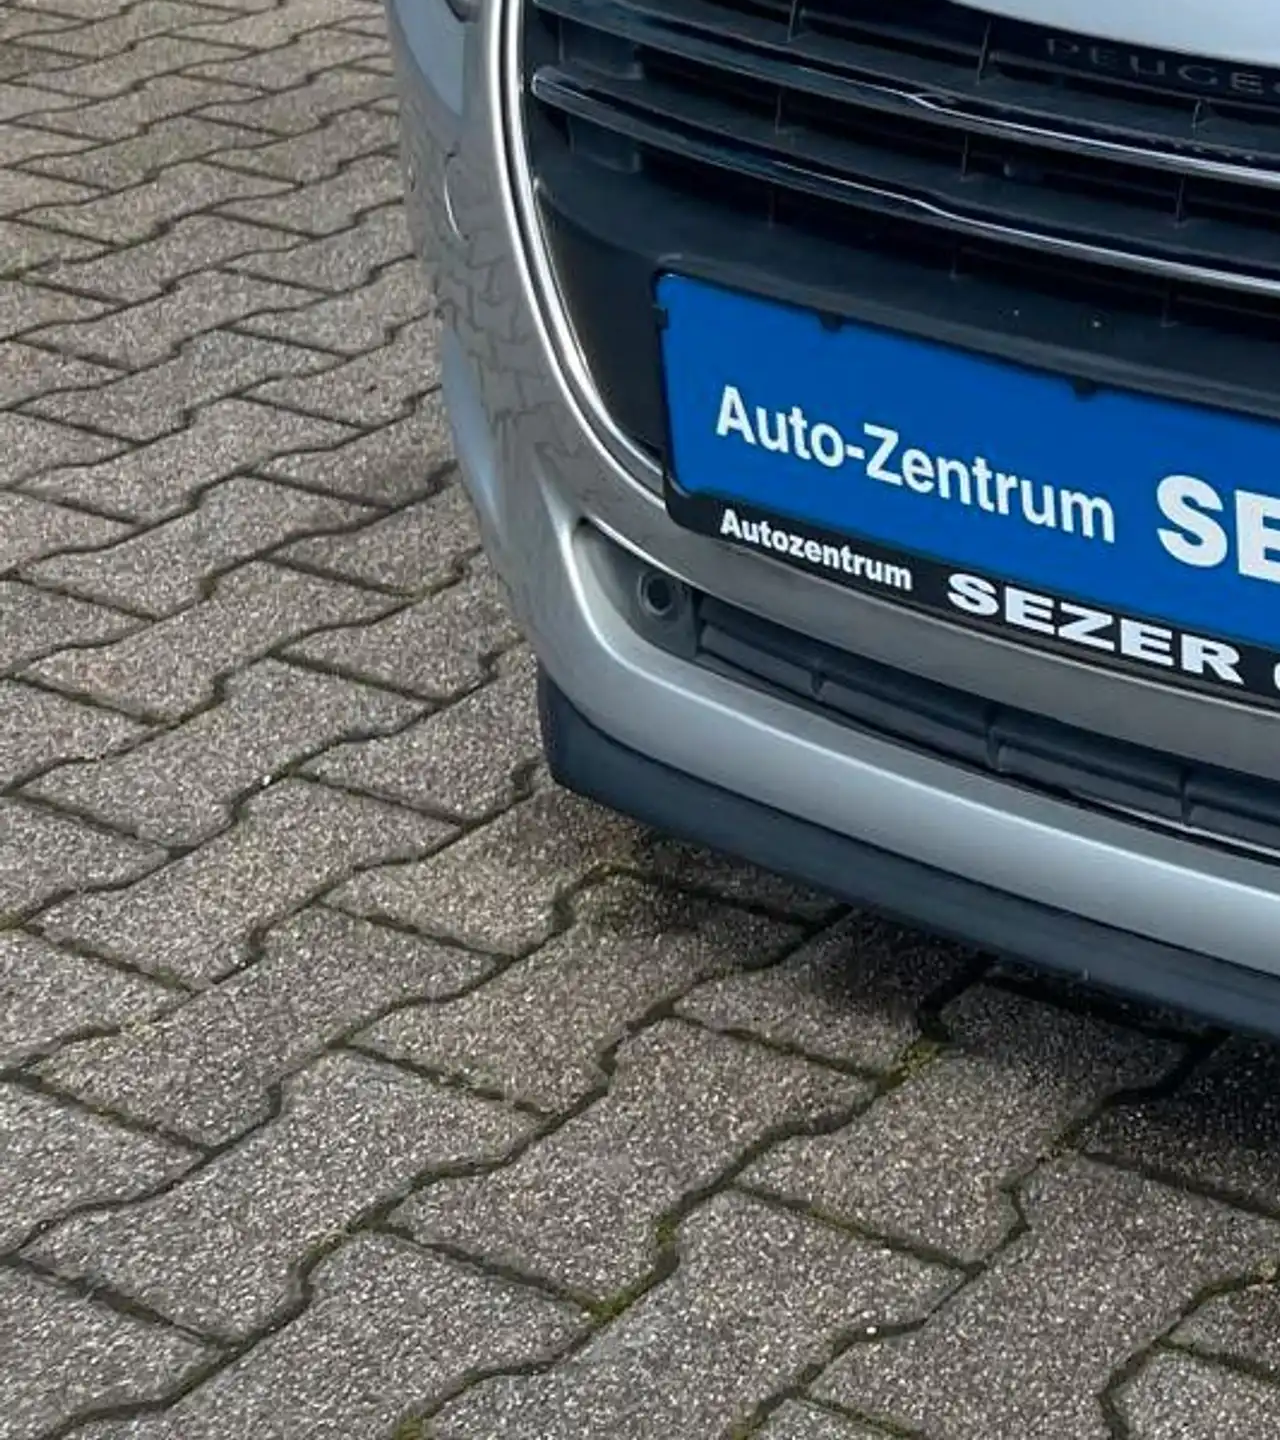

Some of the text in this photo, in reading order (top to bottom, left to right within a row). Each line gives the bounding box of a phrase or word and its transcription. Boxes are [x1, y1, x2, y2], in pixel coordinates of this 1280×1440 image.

[715, 384, 1115, 544] Auto-Zentrum
[719, 508, 913, 592] Autozentrum
[947, 572, 1245, 685] SEZER
